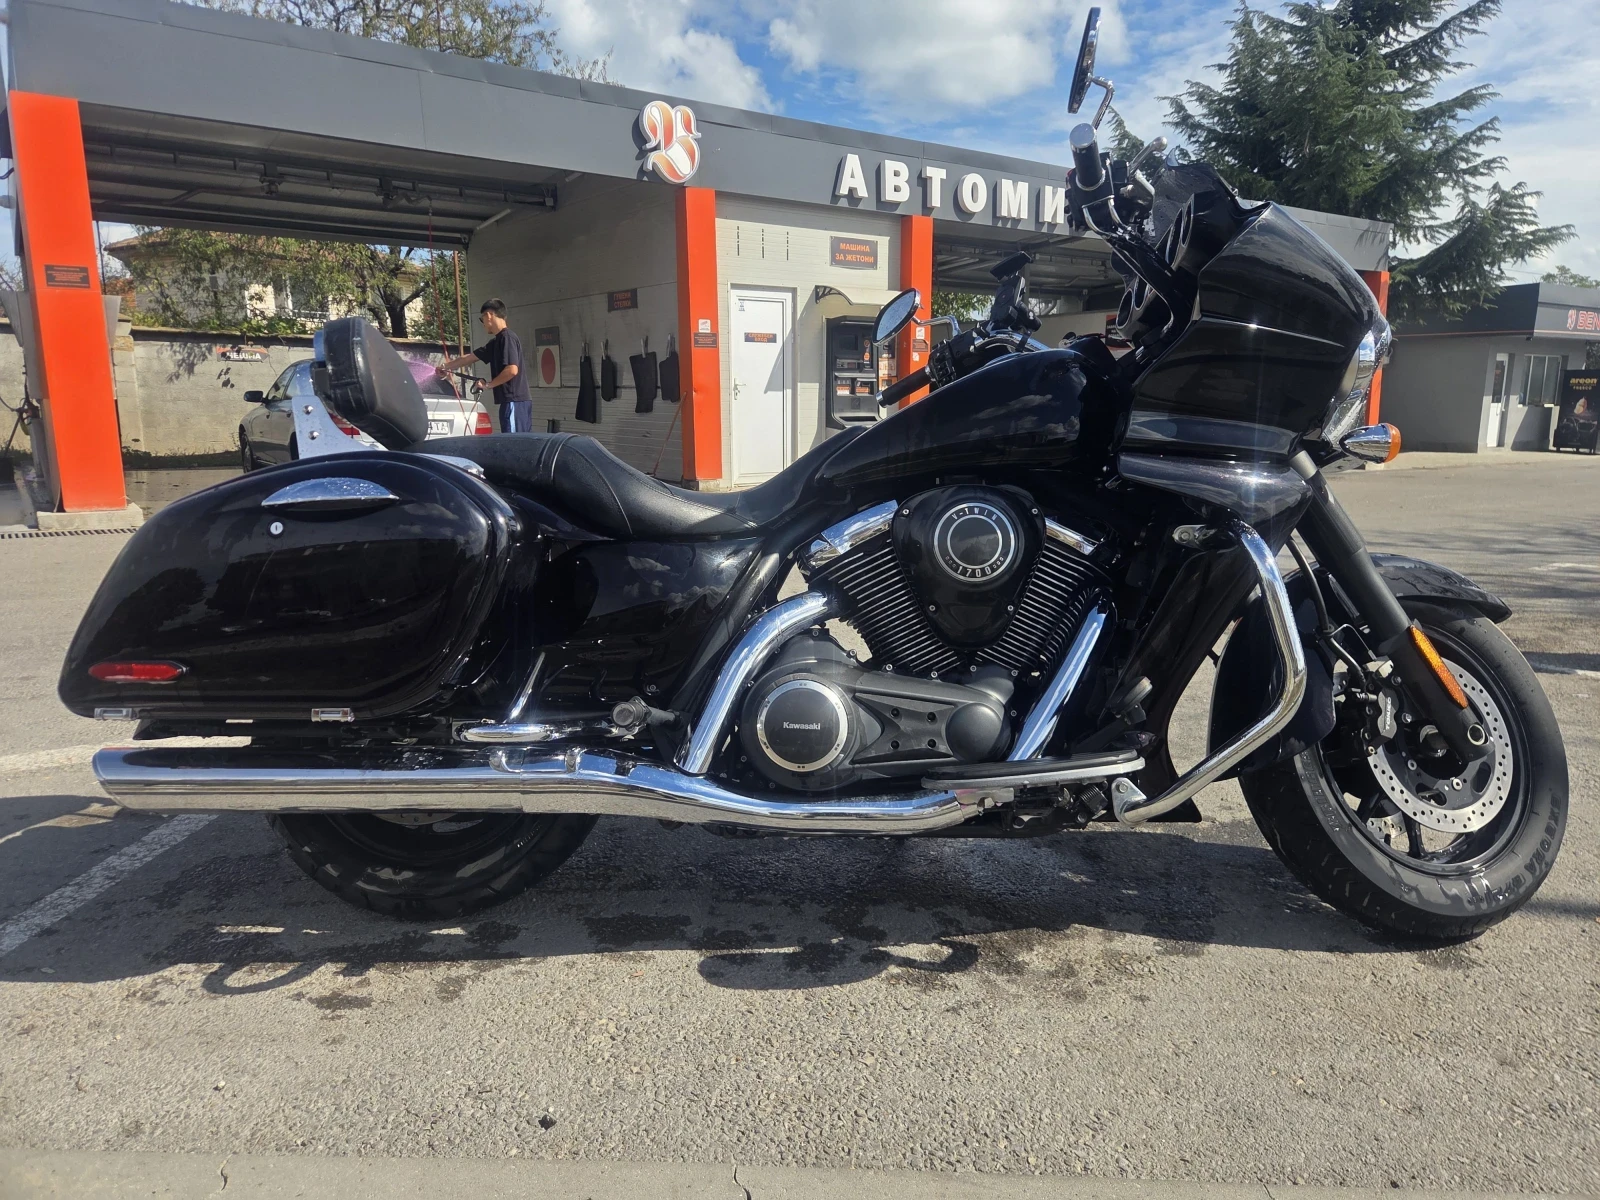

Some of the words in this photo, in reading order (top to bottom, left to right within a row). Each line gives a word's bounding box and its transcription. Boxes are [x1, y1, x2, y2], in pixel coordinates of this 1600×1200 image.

[840, 242, 871, 252] МАШИНА
[835, 253, 845, 261] ЗА
[846, 254, 875, 263] ЖЕТОНИ
[951, 507, 998, 521] V-TWIN
[957, 565, 992, 578] 1700
[783, 721, 821, 731] Kawasaki
